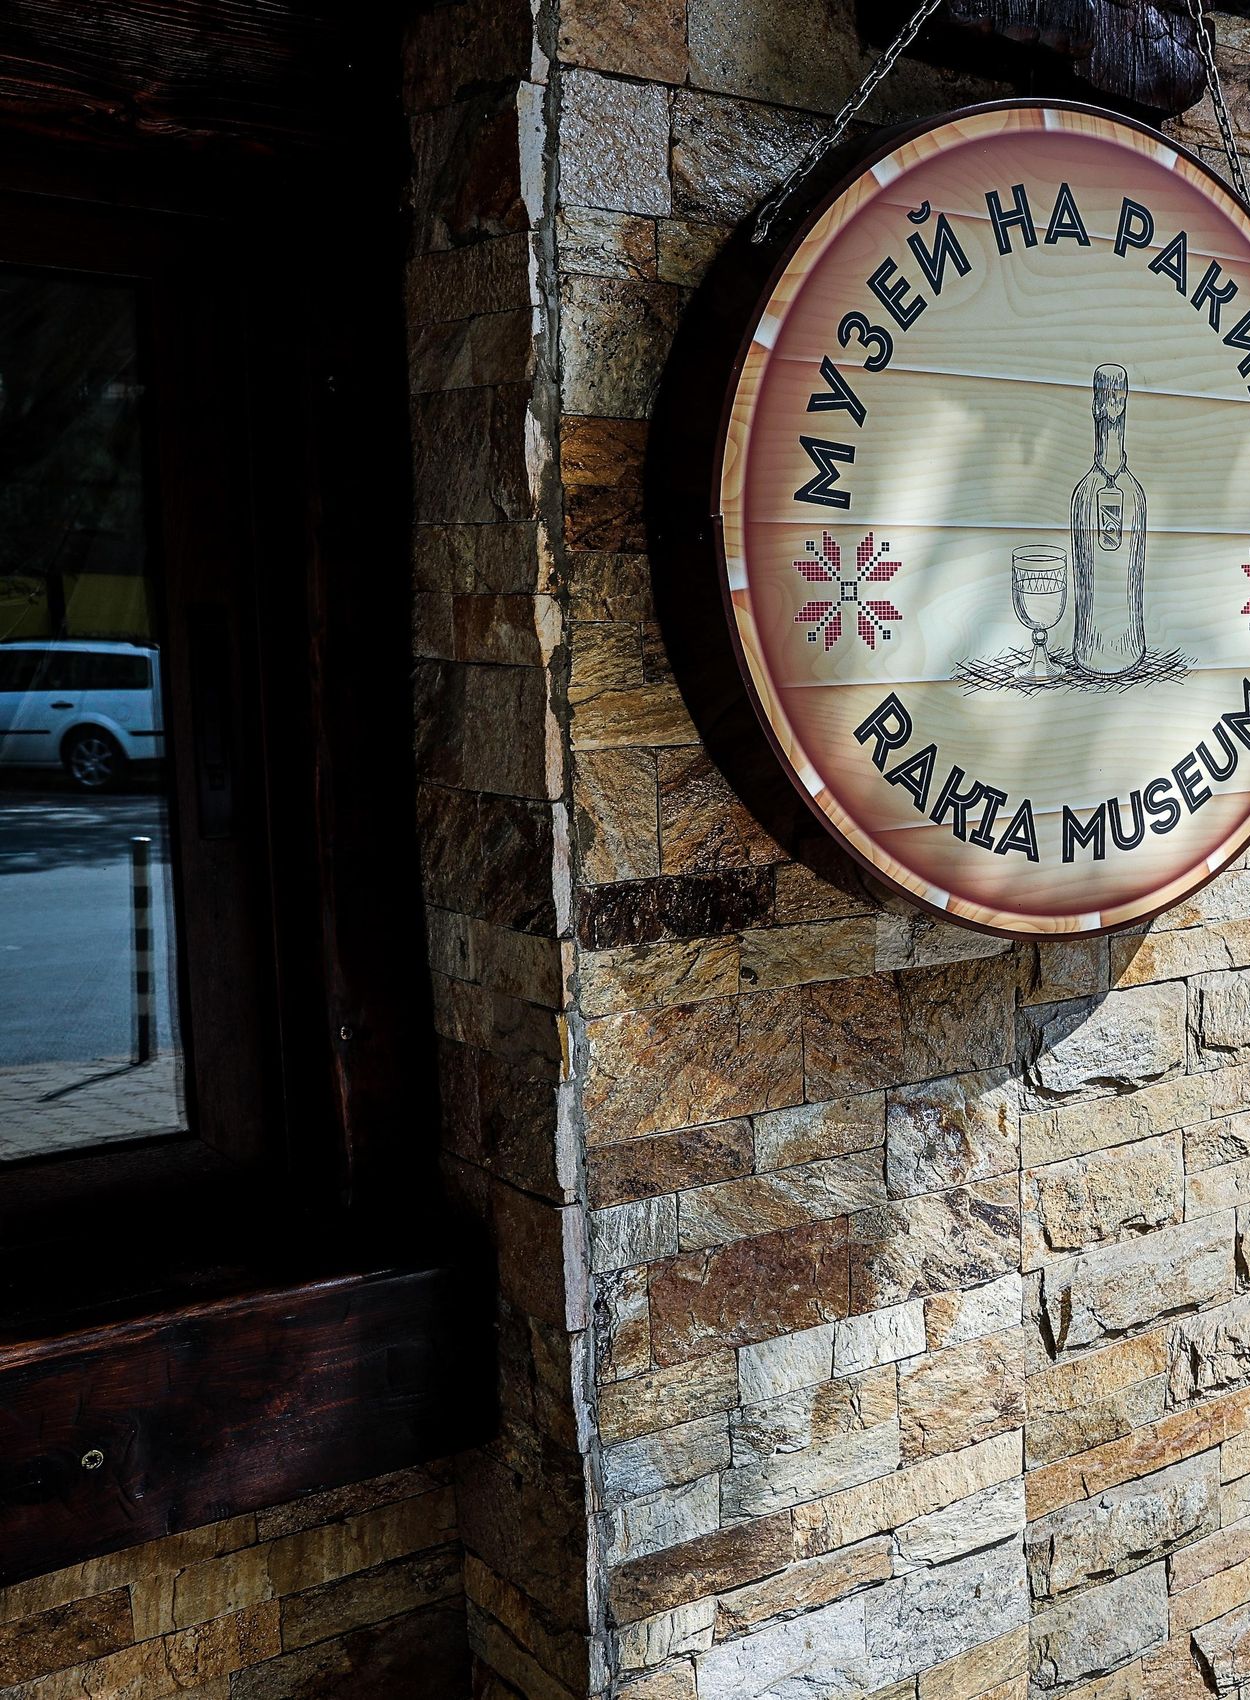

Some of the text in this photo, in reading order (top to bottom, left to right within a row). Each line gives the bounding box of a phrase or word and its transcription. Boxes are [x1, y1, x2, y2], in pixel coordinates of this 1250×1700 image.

[794, 201, 973, 511] МУЗЕЙ
[984, 182, 1092, 255] НА
[852, 691, 1041, 864] RAKIA
